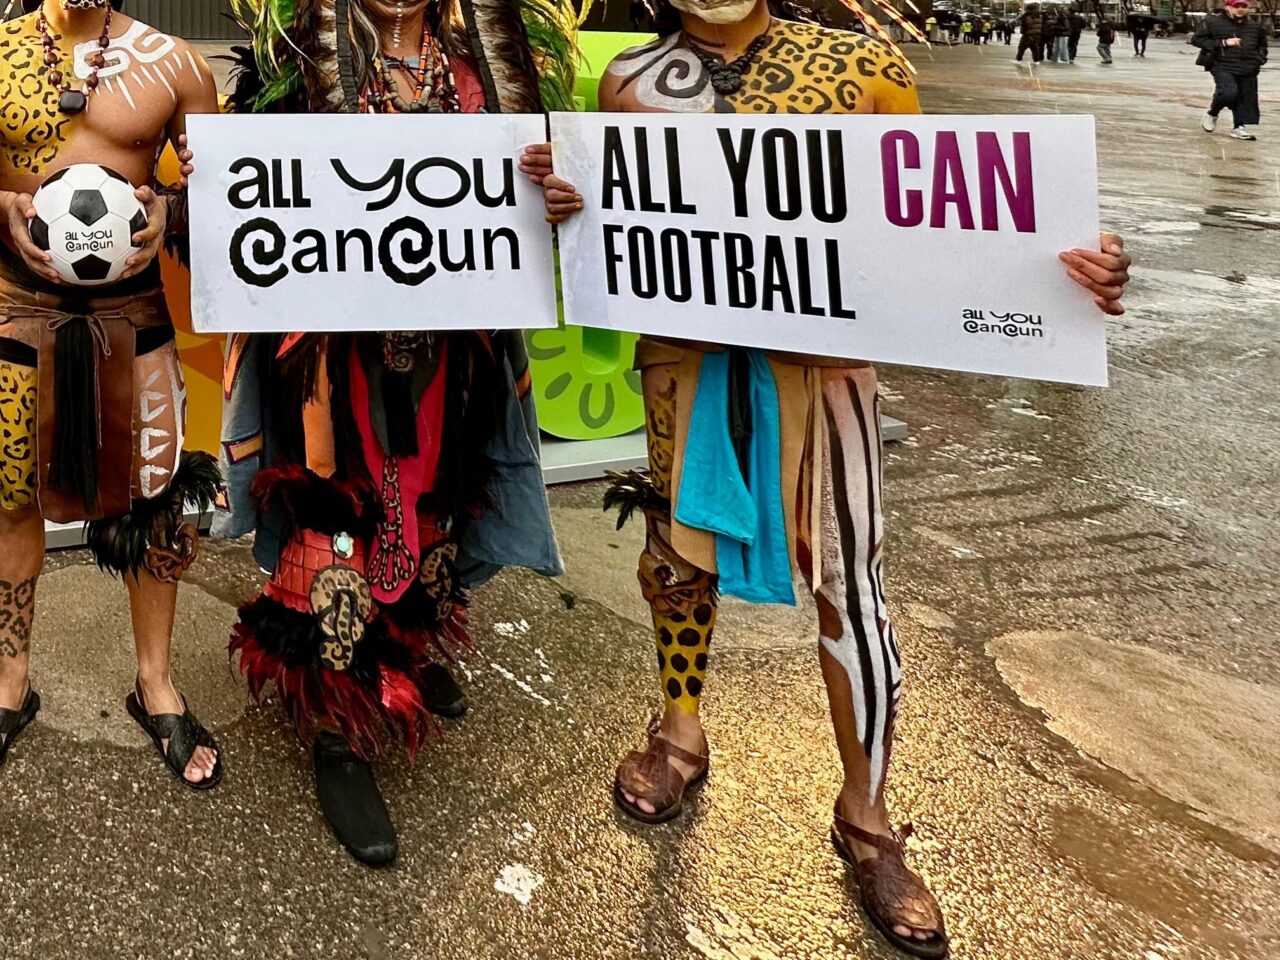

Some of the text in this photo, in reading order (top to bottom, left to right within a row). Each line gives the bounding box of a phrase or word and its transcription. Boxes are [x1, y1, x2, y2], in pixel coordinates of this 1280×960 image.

[602, 127, 1036, 233] ALL YOU CAN
[603, 224, 856, 319] FOOTBALL
